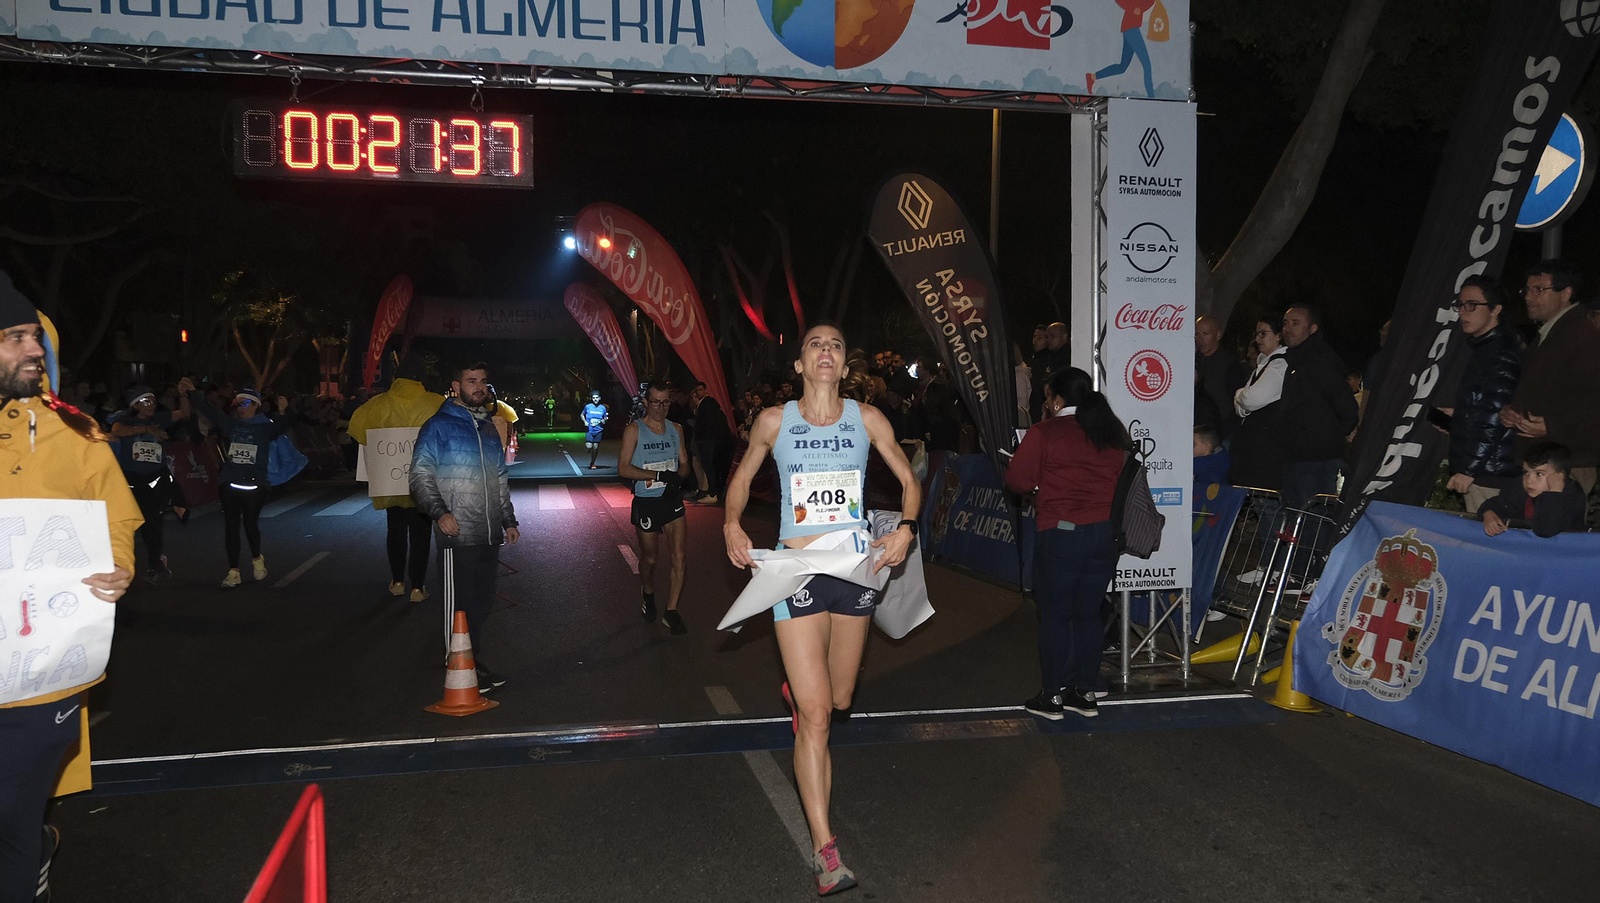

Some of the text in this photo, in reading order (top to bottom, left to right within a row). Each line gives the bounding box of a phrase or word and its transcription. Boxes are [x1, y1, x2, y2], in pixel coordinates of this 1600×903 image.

[1119, 175, 1182, 188] RENAULT
[1119, 187, 1182, 198] SYRSA AUTOMOCION
[1119, 242, 1179, 253] NISSAN
[1125, 275, 1177, 284] andalmotor.es
[1115, 302, 1188, 331] Coca-Cola
[643, 440, 671, 451] nerja
[794, 435, 855, 452] nerja
[140, 447, 156, 455] 345
[233, 449, 250, 457] 343
[802, 452, 848, 460] ATLETISMO
[806, 489, 846, 506] 408
[953, 510, 973, 532] DE
[1115, 567, 1177, 579] RENAULT
[1135, 579, 1176, 588] AUTOMOCION
[1453, 638, 1518, 694] DE
[1339, 673, 1361, 686] CIUDAD
